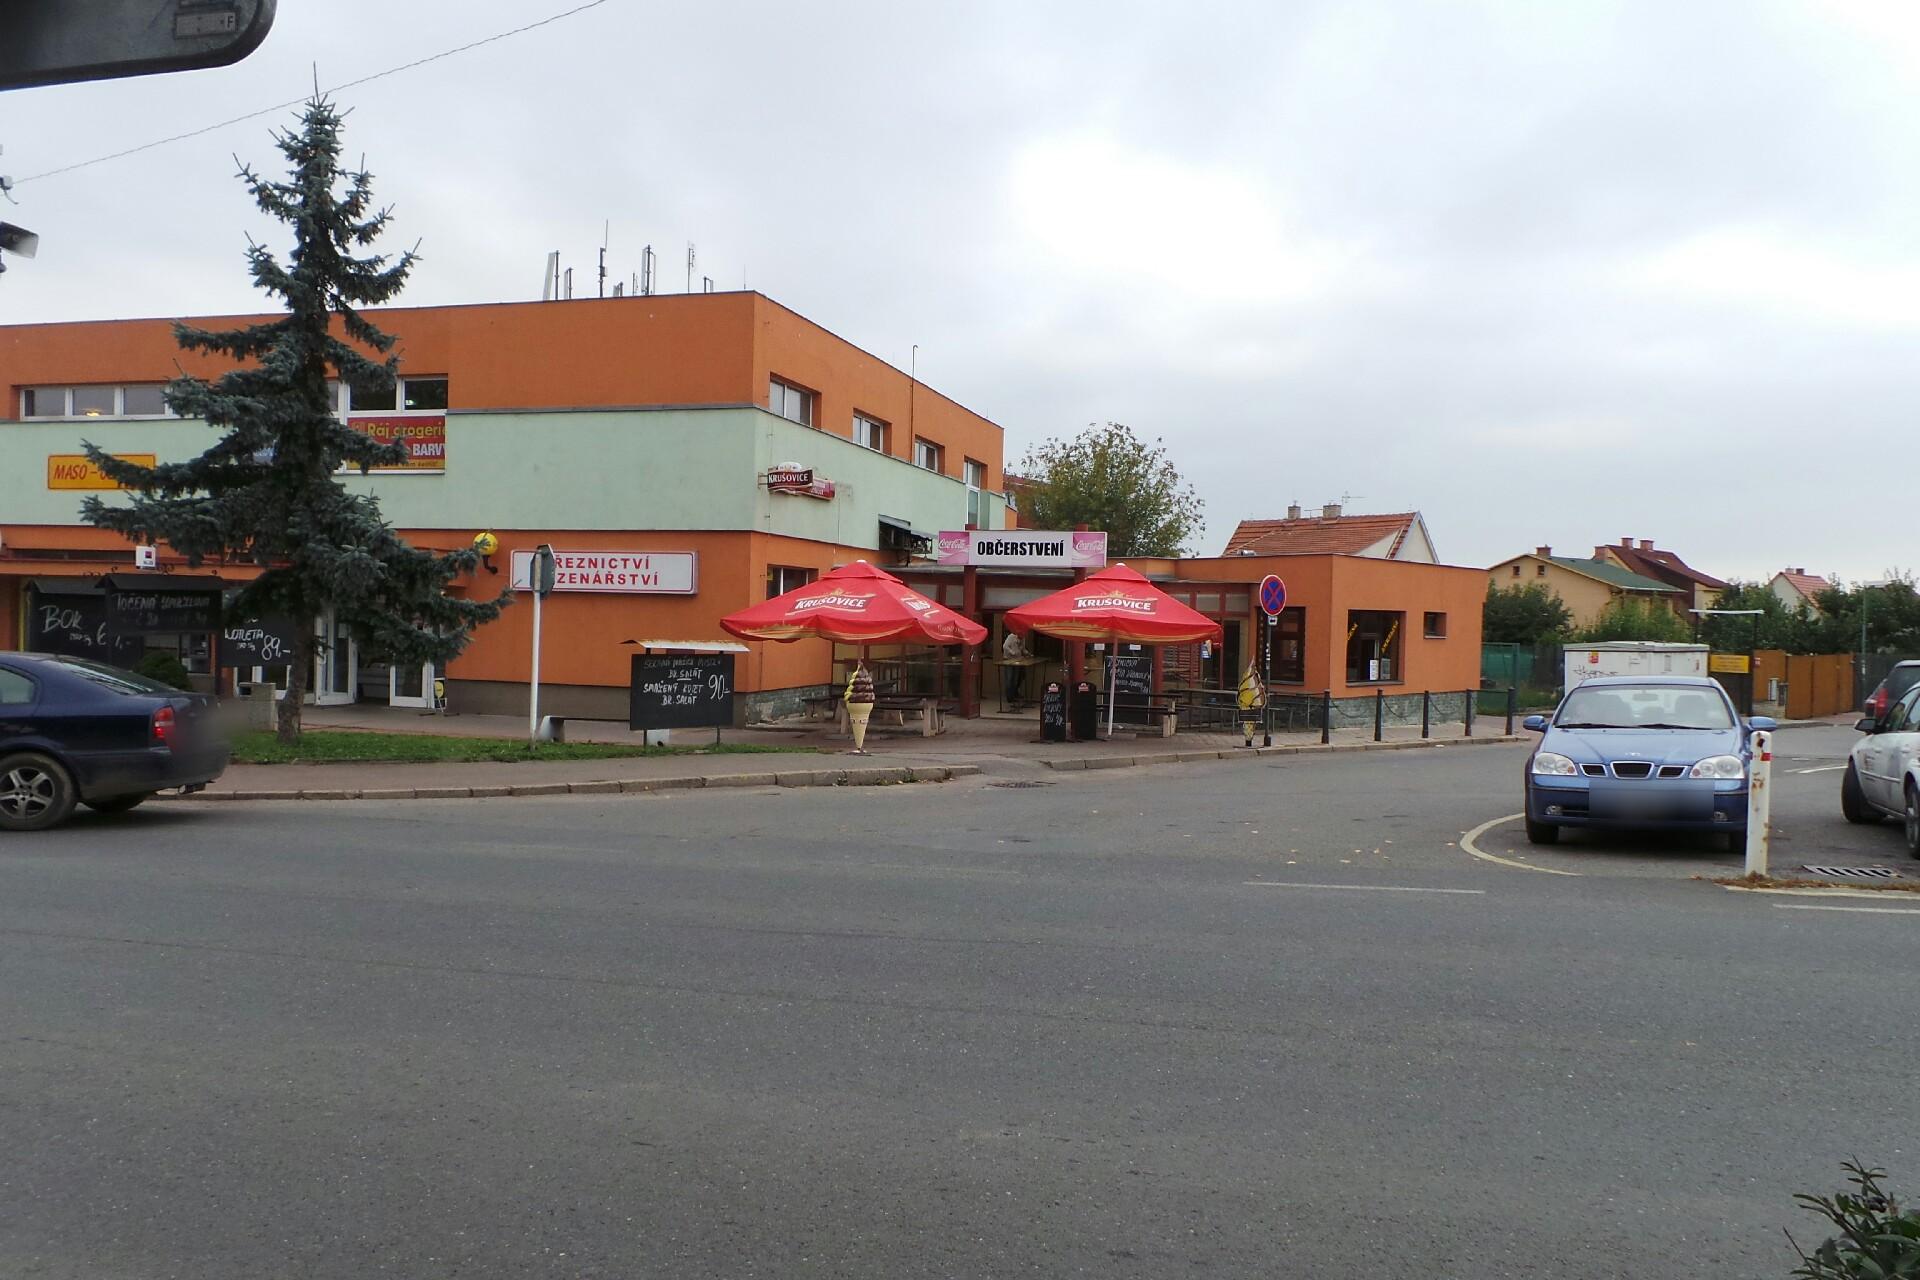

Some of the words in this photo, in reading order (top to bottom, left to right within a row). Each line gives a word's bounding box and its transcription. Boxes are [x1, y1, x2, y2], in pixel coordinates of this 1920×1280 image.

[367, 422, 389, 439] Ráj
[54, 464, 87, 480] MASO
[768, 472, 809, 484] KRUŠOVICE
[977, 538, 1065, 557] OBČERSTVENÍ
[557, 570, 659, 586] ZENÁŘSTVÍ
[795, 596, 867, 610] KRUŠOVICE
[1077, 598, 1152, 611] KRUŠOVICE
